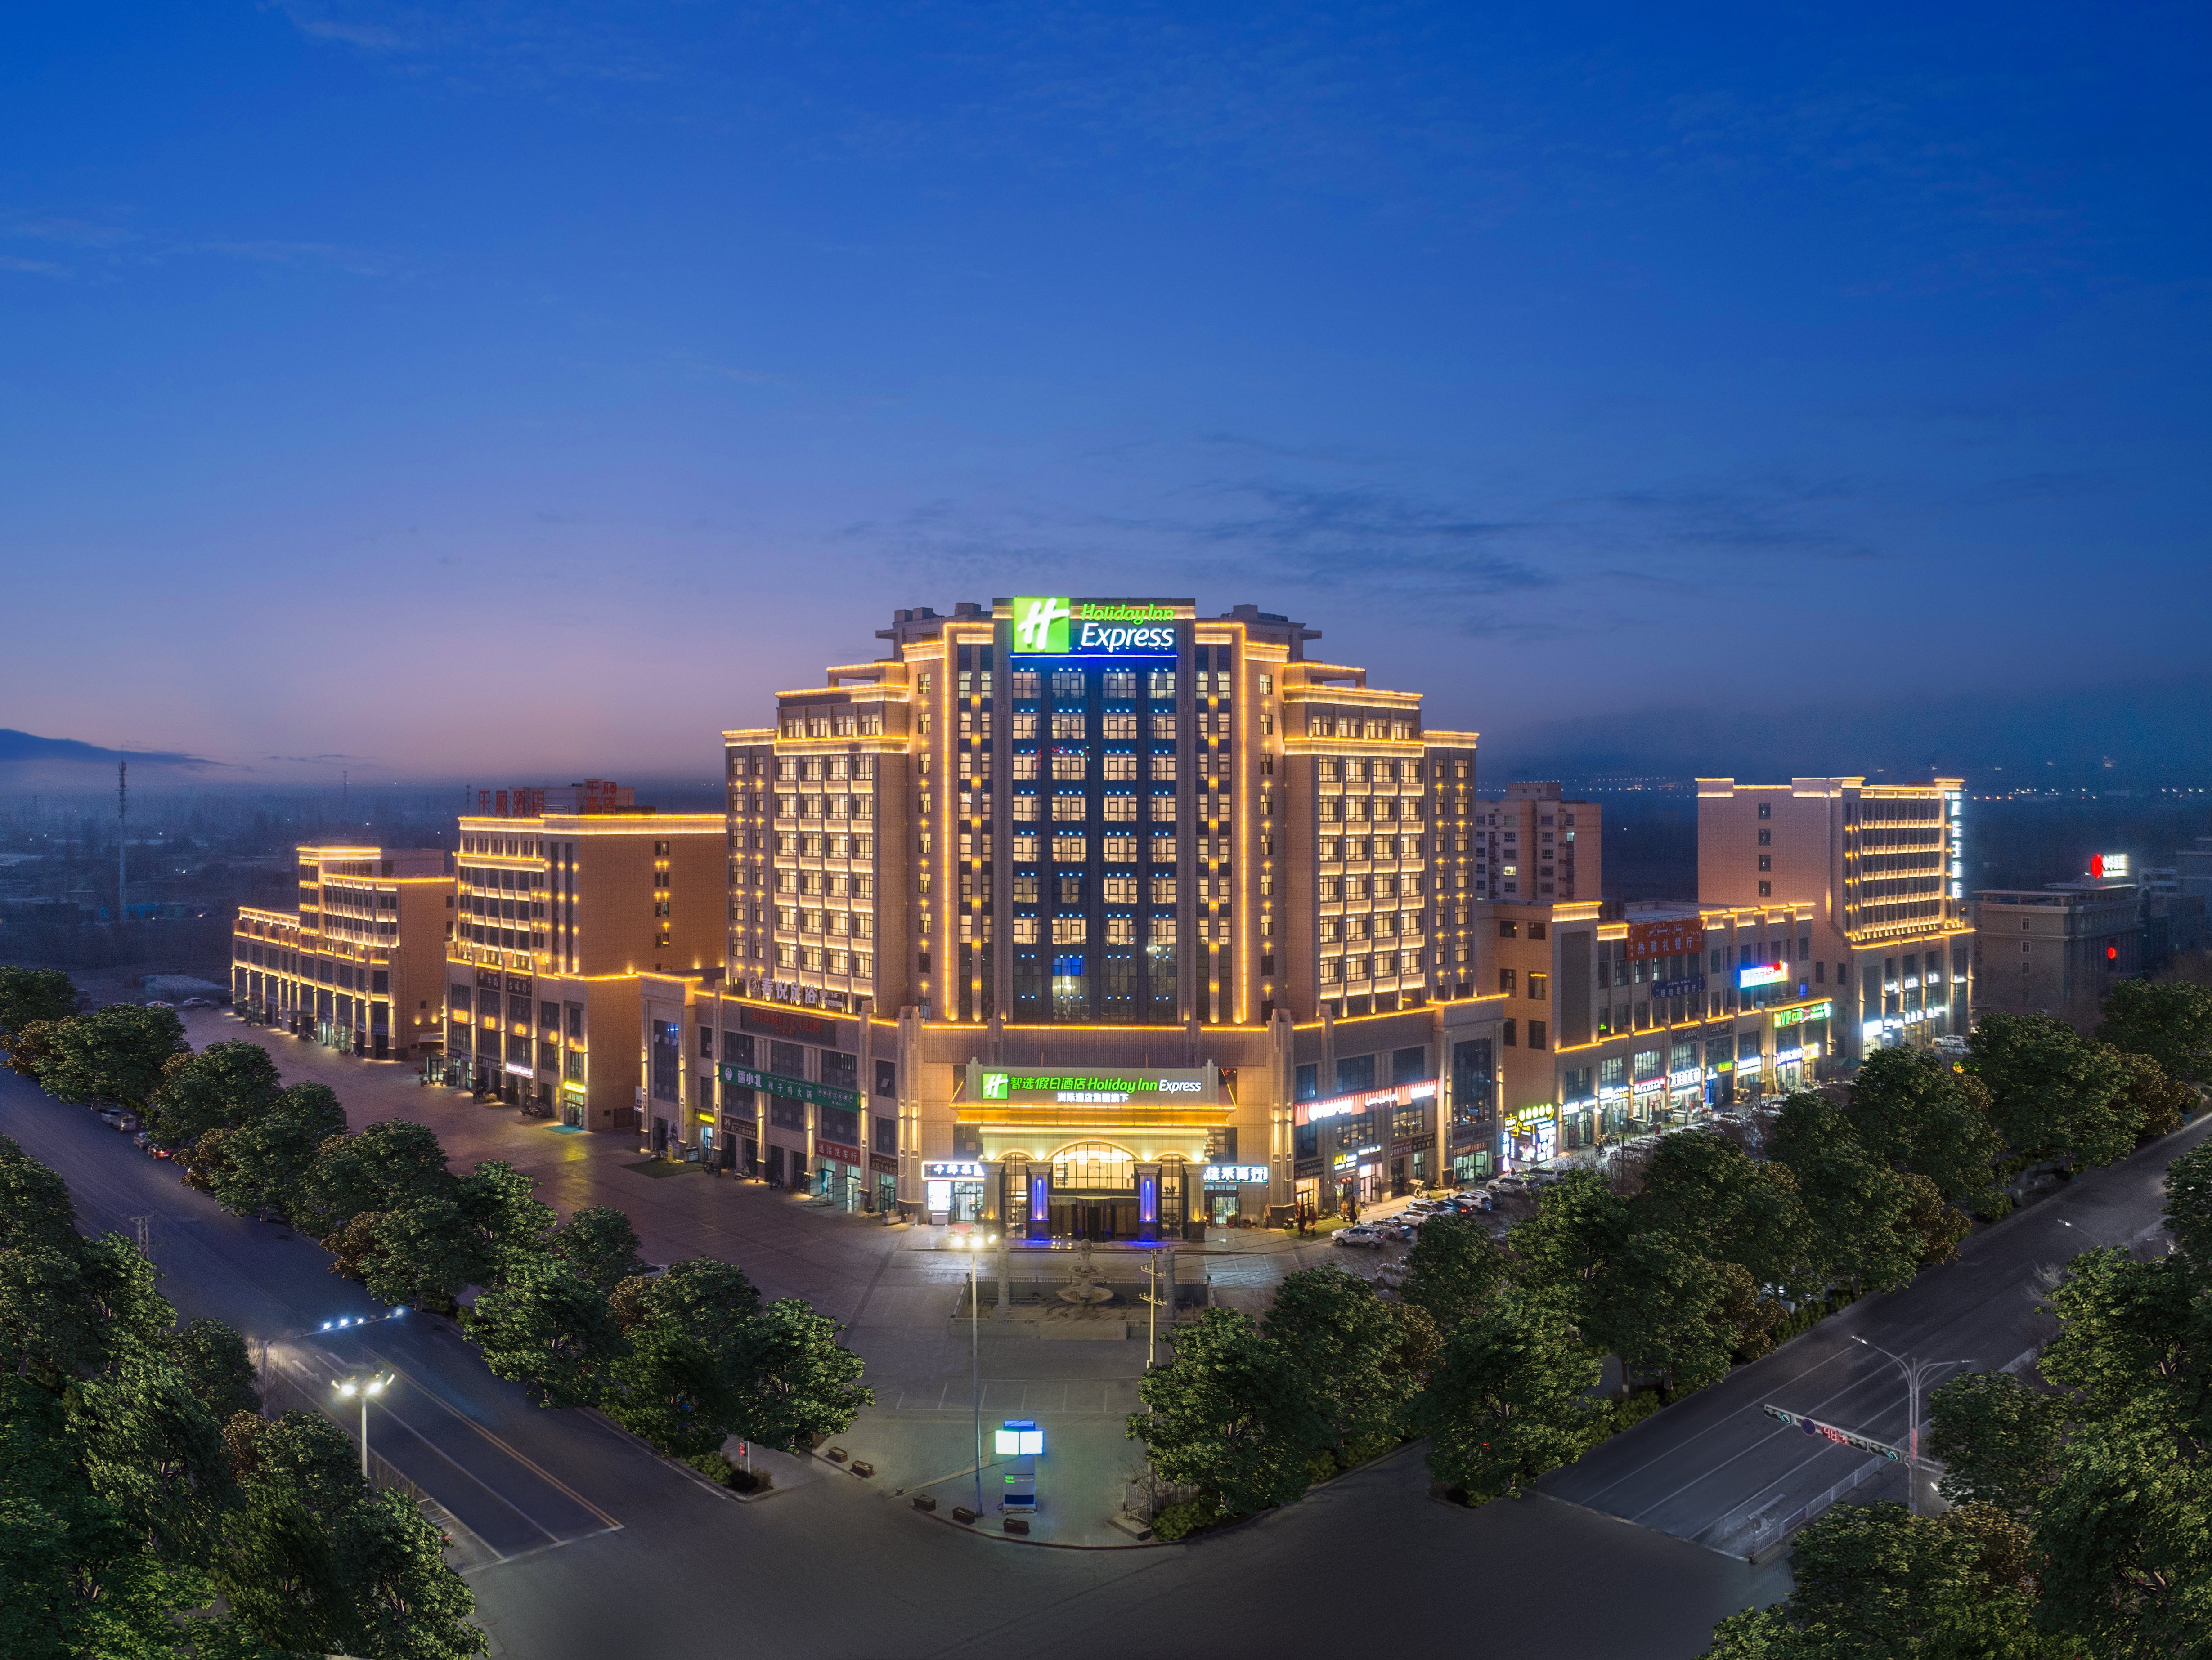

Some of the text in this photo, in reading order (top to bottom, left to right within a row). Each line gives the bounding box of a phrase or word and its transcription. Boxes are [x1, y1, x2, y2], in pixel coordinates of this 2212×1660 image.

[1081, 603, 1174, 625] Holiday Inn
[1081, 622, 1174, 653] Express
[1781, 1010, 1792, 1025] VIP
[1792, 1011, 1804, 1022] CLUB
[1684, 1029, 1697, 1038] 2020
[1010, 1077, 1202, 1094] 智选假日酒店 Holiday Inn Express
[1057, 1092, 1129, 1103] 洲际酒店集团旗下
